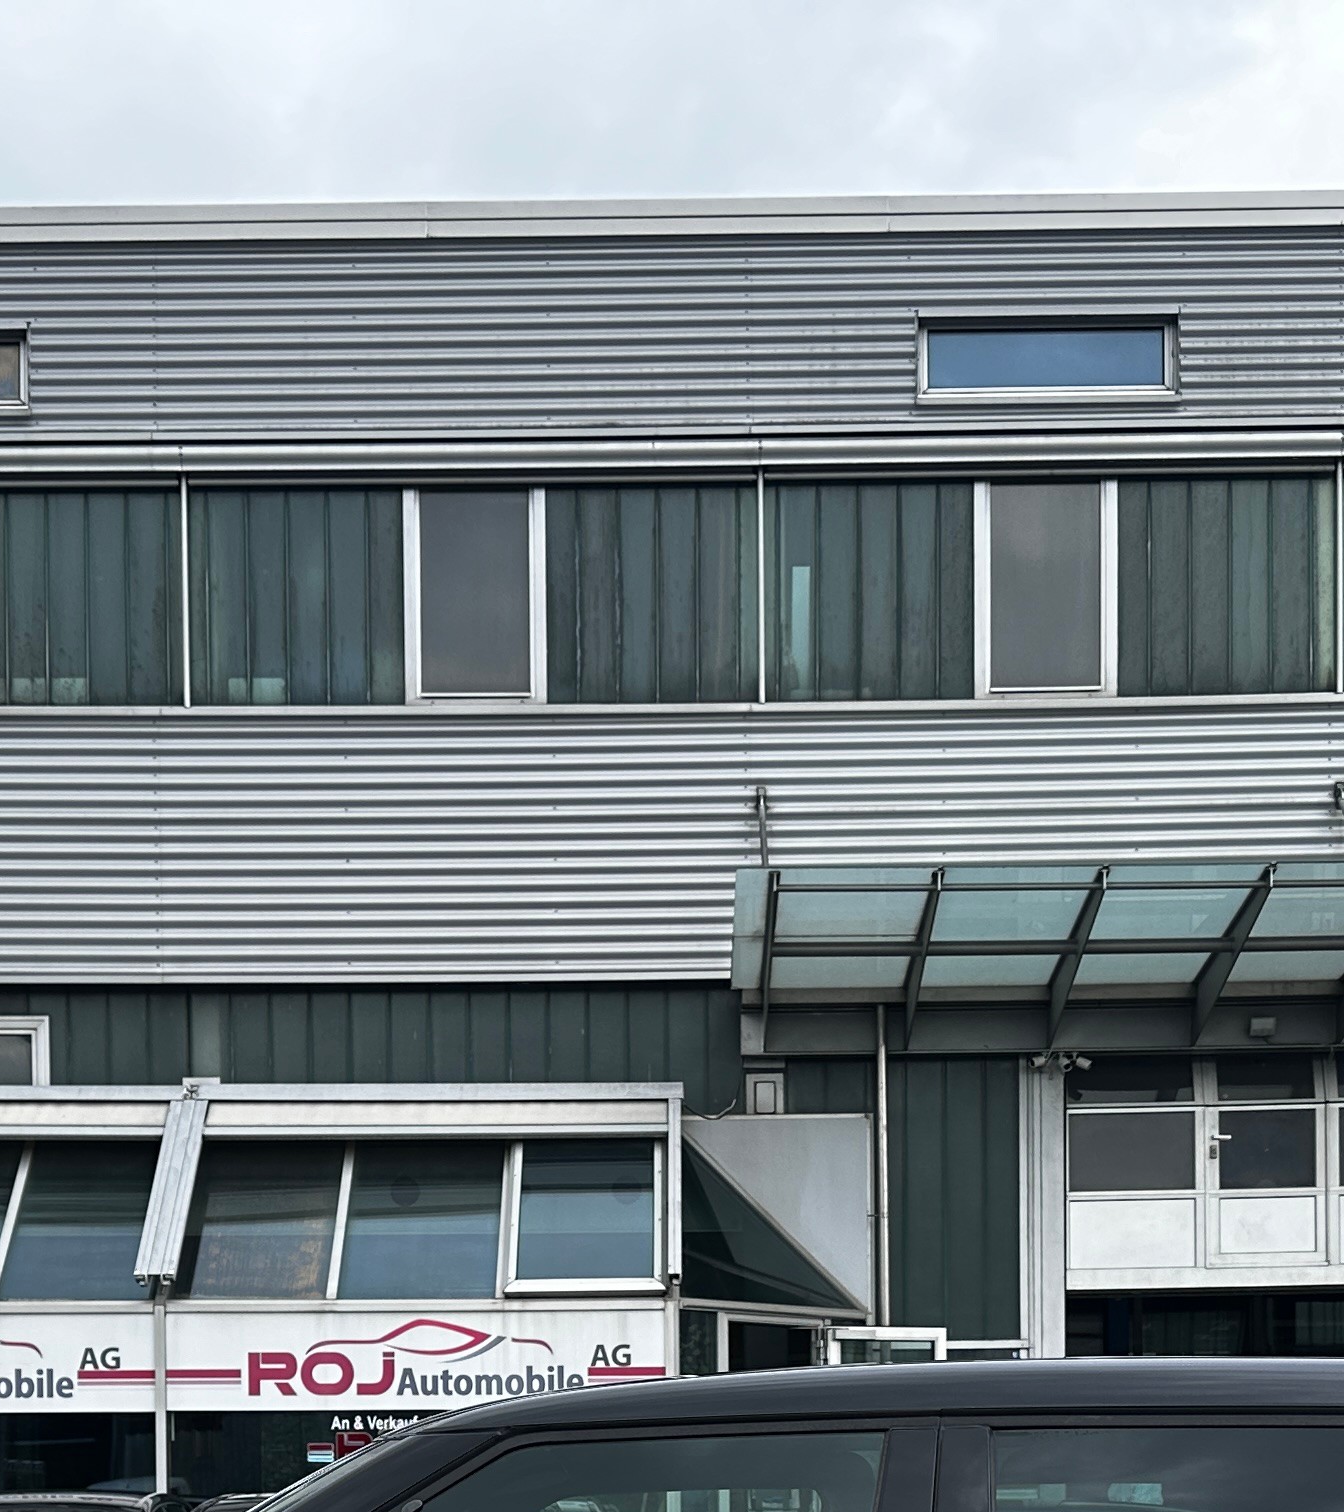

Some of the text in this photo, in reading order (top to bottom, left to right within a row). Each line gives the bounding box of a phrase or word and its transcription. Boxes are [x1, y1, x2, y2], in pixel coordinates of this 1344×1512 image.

[80, 1347, 121, 1370] AG
[248, 1344, 631, 1396] ROJ Automobile AG
[331, 1416, 350, 1430] An
[353, 1416, 364, 1430] &
